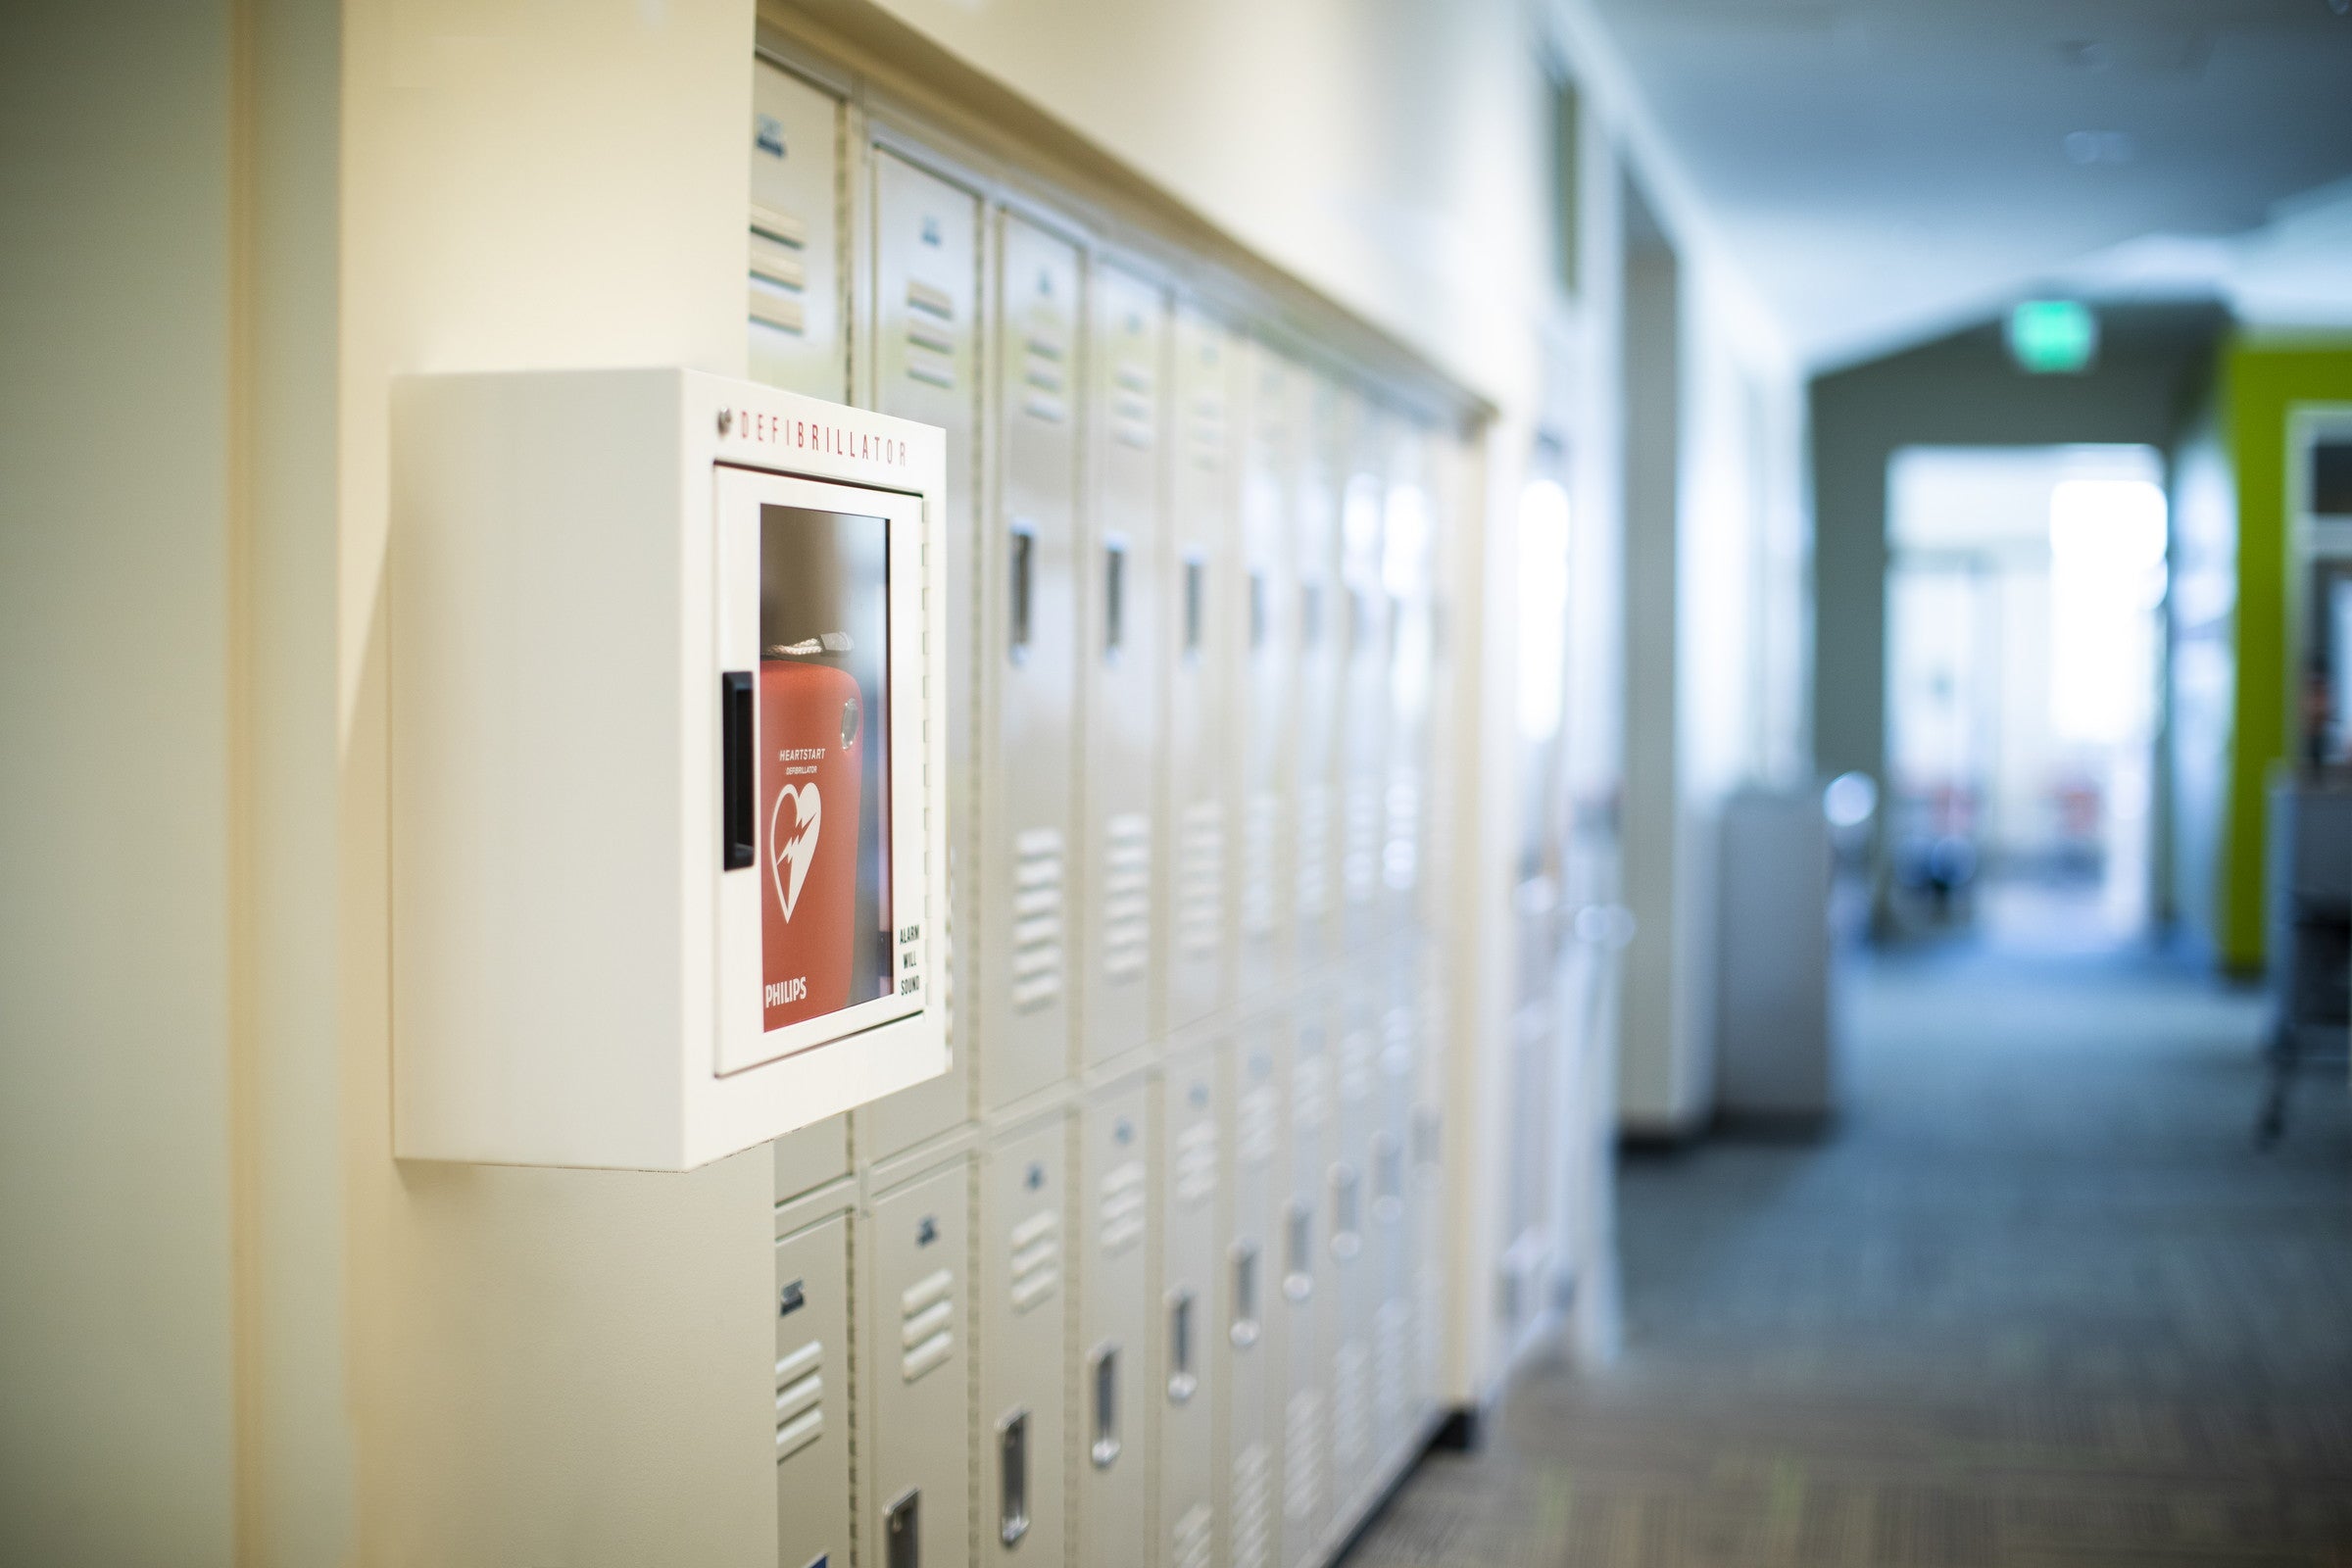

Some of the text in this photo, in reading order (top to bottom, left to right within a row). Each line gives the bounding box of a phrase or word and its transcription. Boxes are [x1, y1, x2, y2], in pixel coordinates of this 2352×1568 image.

[741, 411, 906, 466] DEFIBRILLATOR
[780, 749, 825, 760] HEARTSTART
[786, 765, 817, 775] DEFIBRILLATOR
[900, 924, 919, 944] ALARM
[903, 951, 916, 968] WILL
[765, 976, 807, 1007] PHILIPS
[901, 975, 919, 996] SOUND
